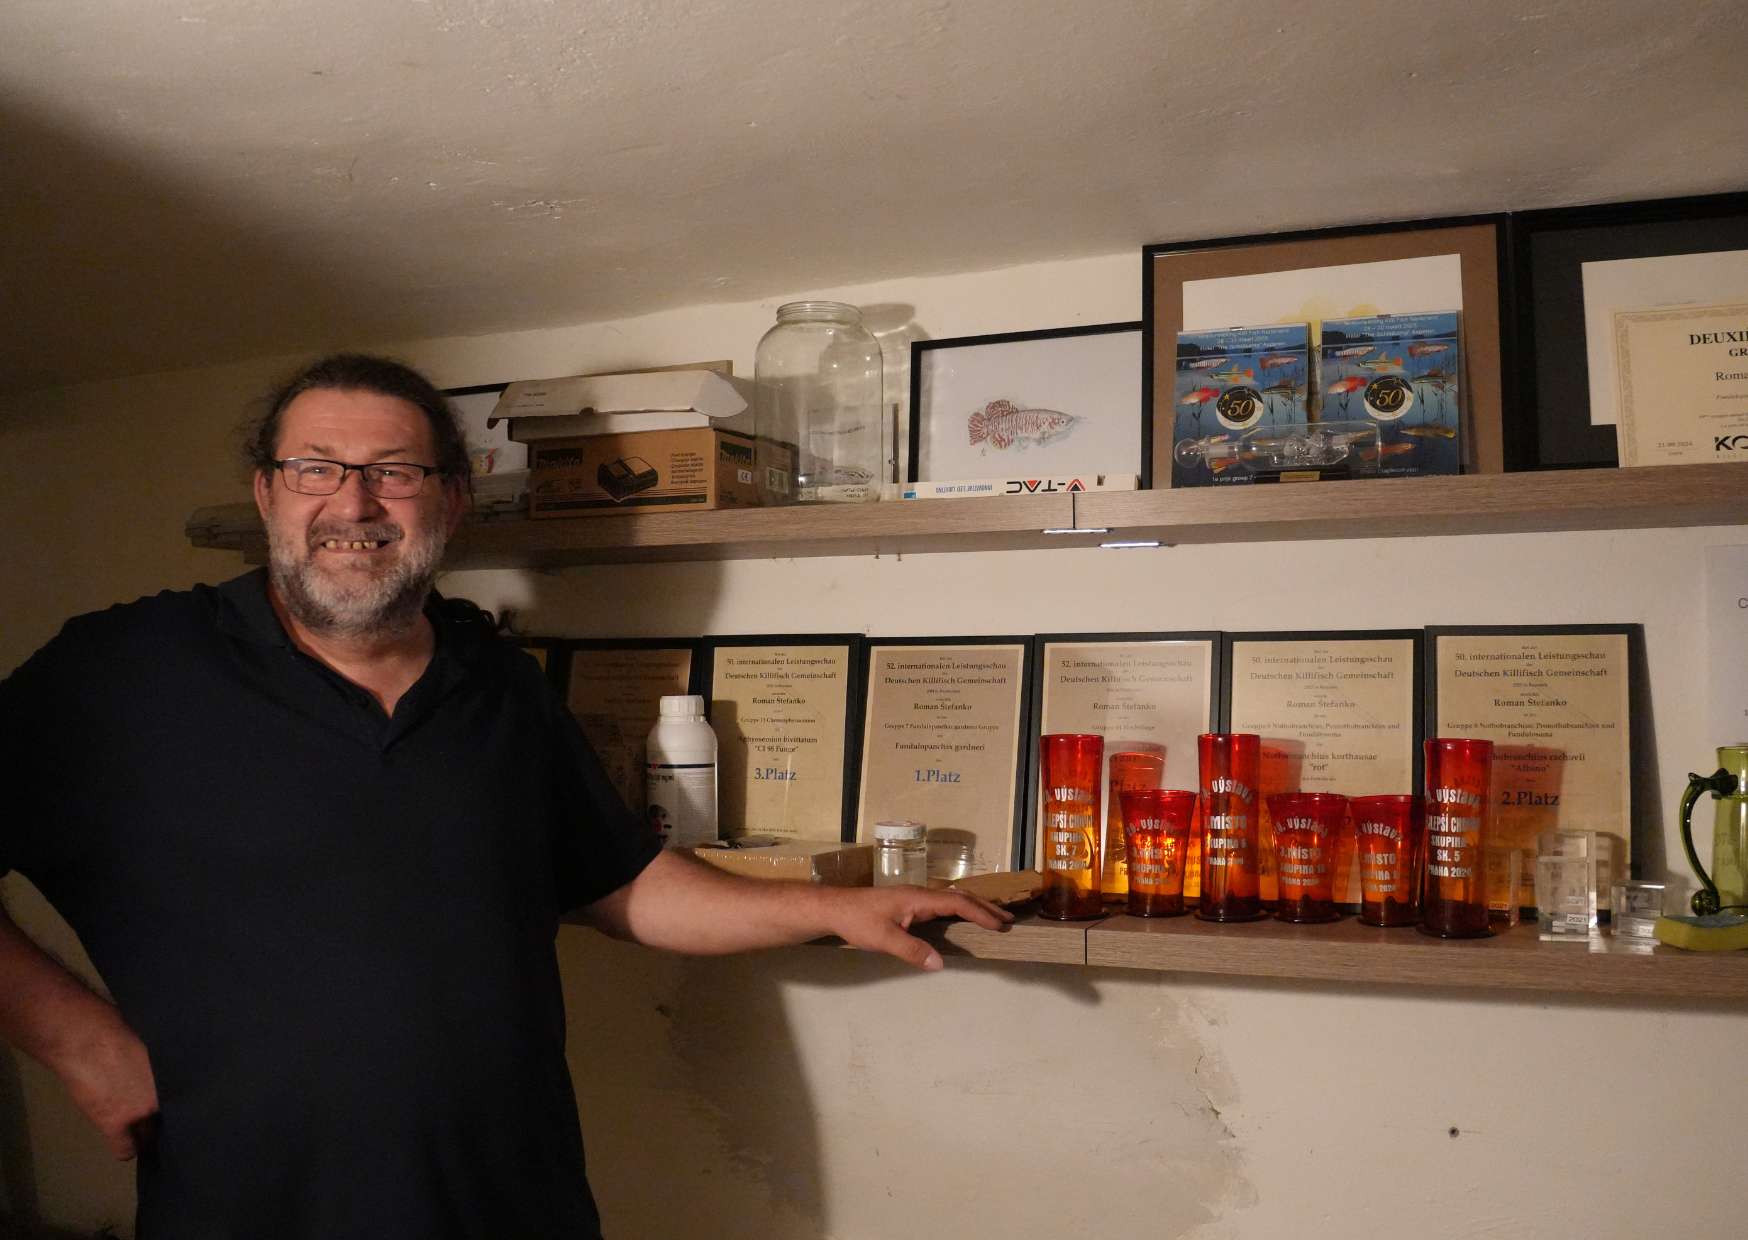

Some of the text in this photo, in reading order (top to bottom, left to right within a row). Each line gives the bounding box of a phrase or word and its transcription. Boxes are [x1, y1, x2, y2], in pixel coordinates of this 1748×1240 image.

[1376, 389, 1406, 406] 50
[1226, 400, 1252, 416] 50
[1264, 655, 1327, 664] internationalen
[1329, 655, 1393, 664] Leistungsschau
[1470, 652, 1535, 661] internationalen
[1538, 652, 1606, 661] Leistungsschau
[786, 658, 836, 666] Leistungsschau
[897, 662, 950, 670] internationalen
[952, 662, 1007, 670] Leistungsschau
[1250, 672, 1394, 680] Deutschen Killifisch Gemeinschaft
[1454, 669, 1608, 677] Deutschen Killifisch Gemeinschaft
[1060, 675, 1099, 683] Deutschen
[914, 702, 938, 710] Roman
[1093, 702, 1120, 710] Roman
[1286, 700, 1316, 708] Roman
[1494, 698, 1525, 707] Roman
[754, 767, 797, 781] 3.Platz
[915, 769, 961, 783] 1.Platz
[1502, 791, 1560, 806] 2.Platz
